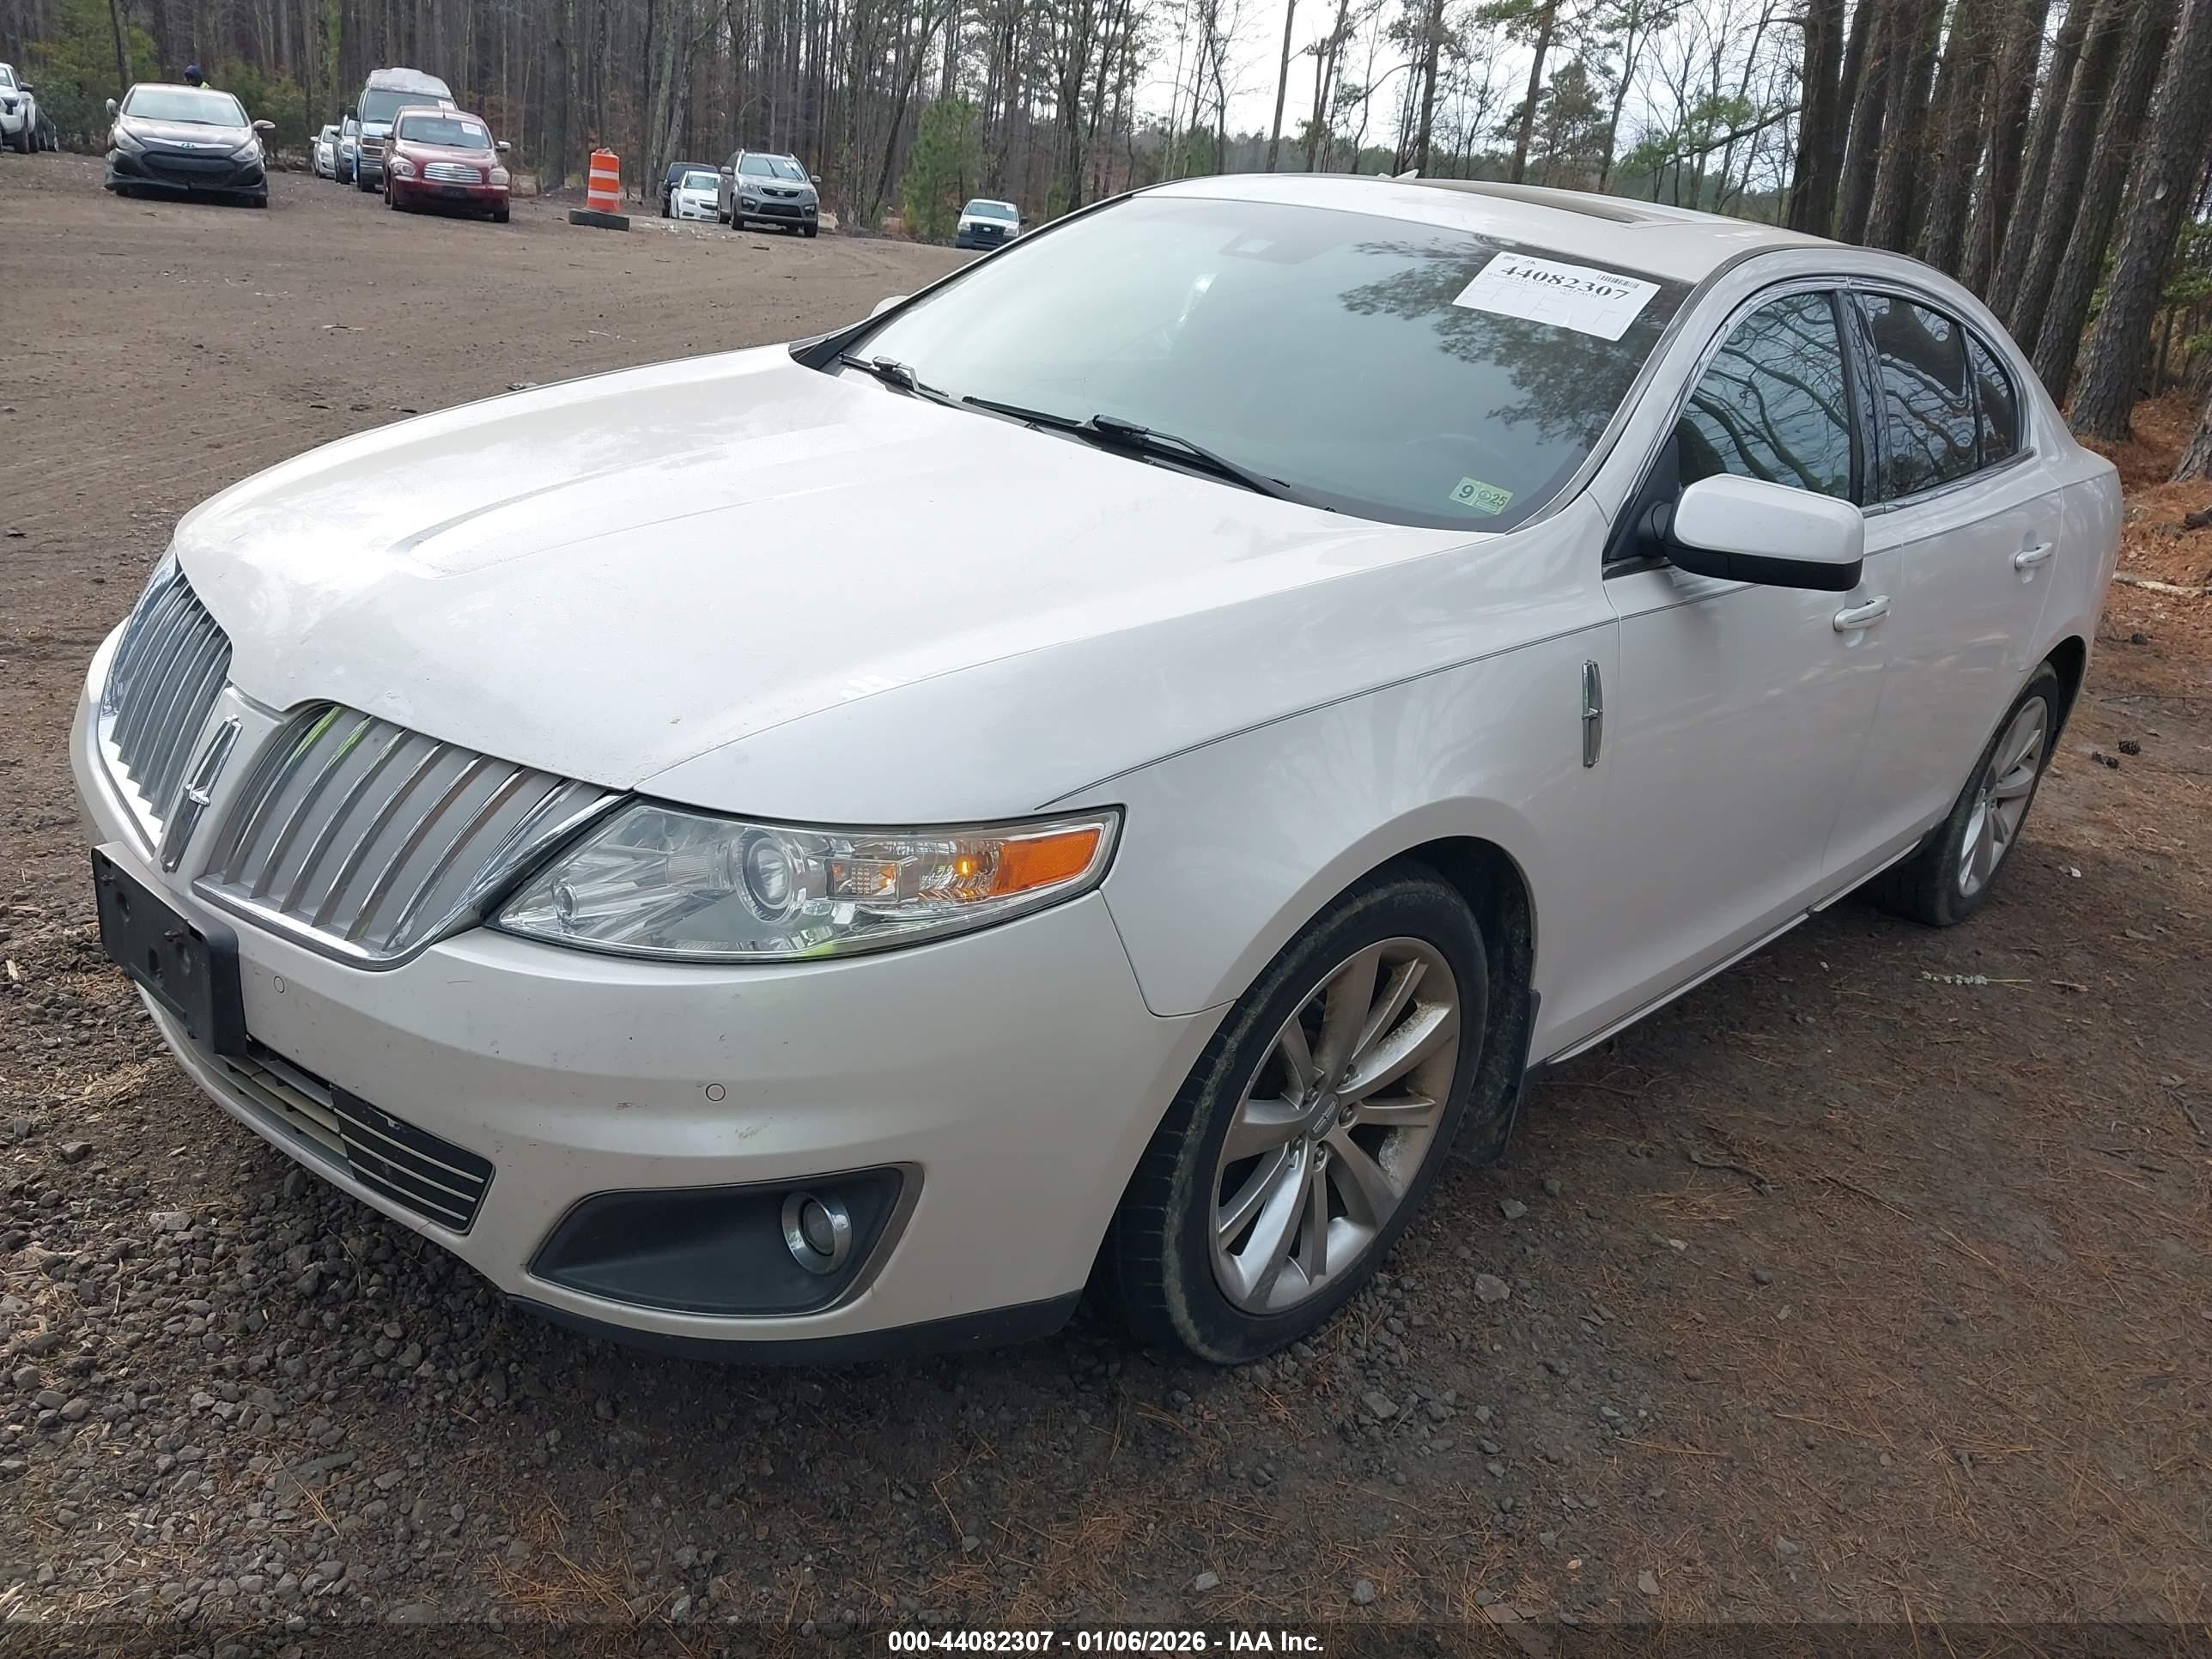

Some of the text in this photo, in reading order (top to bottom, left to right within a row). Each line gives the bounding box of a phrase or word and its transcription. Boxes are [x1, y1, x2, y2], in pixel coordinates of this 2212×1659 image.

[1501, 264, 1631, 301] 44082307
[1458, 484, 1474, 499] 9
[1488, 493, 1508, 507] 25
